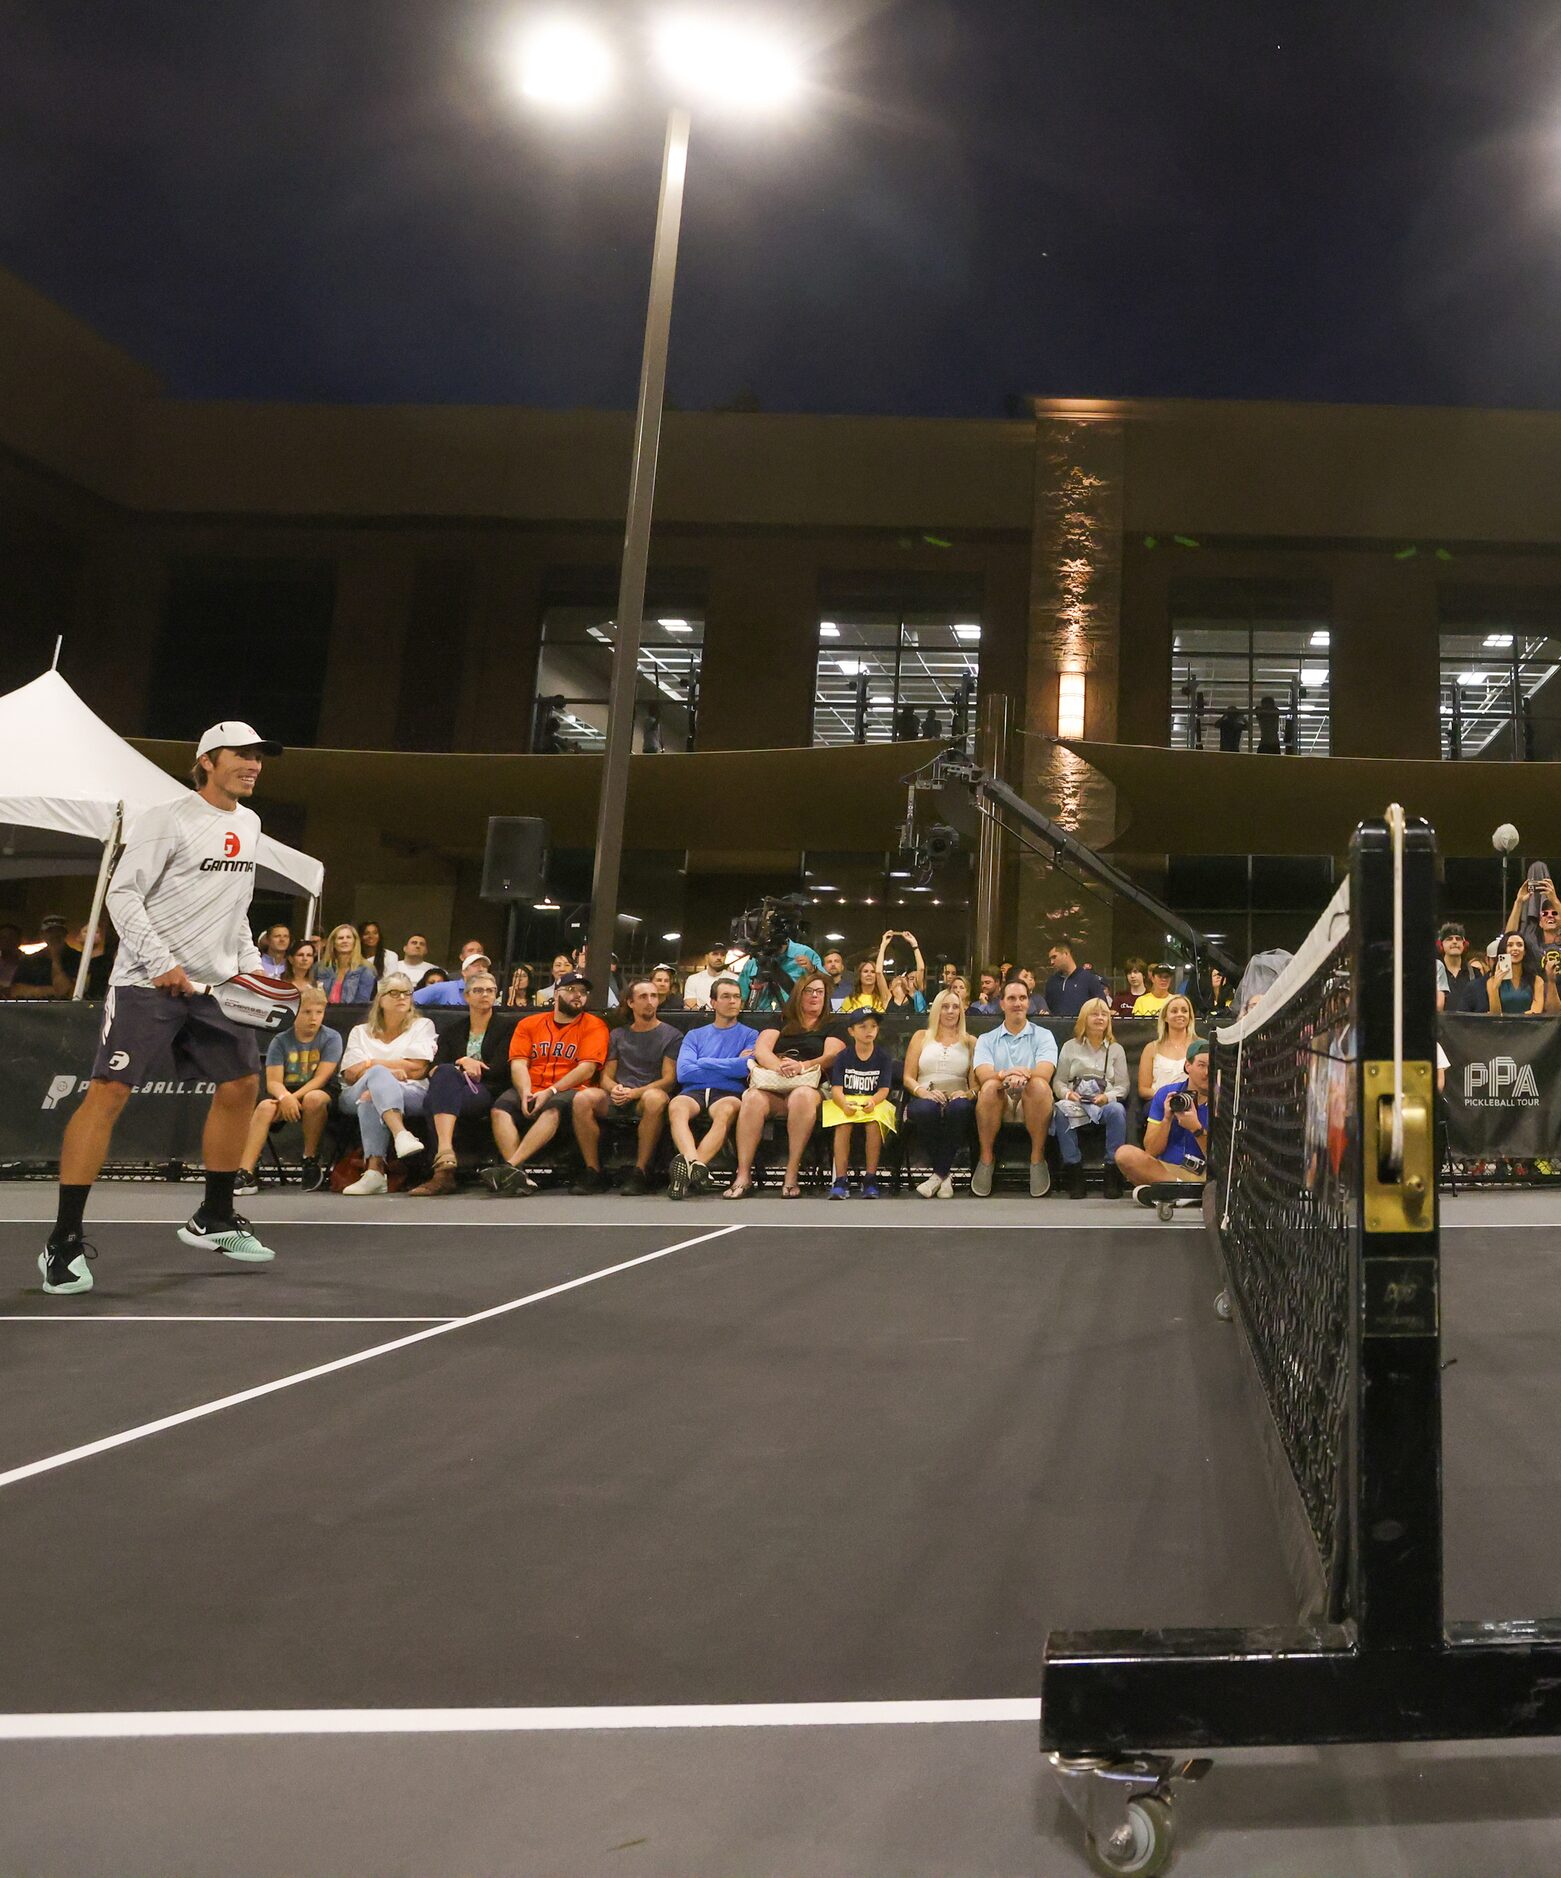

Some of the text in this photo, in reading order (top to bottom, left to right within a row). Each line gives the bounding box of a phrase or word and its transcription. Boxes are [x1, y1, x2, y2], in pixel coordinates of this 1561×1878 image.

[200, 857, 254, 873] GAMMA
[844, 1074, 879, 1091] COWBOYS
[1464, 1056, 1539, 1097] PPA
[1464, 1098, 1540, 1107] PICKLEBALL TOUR
